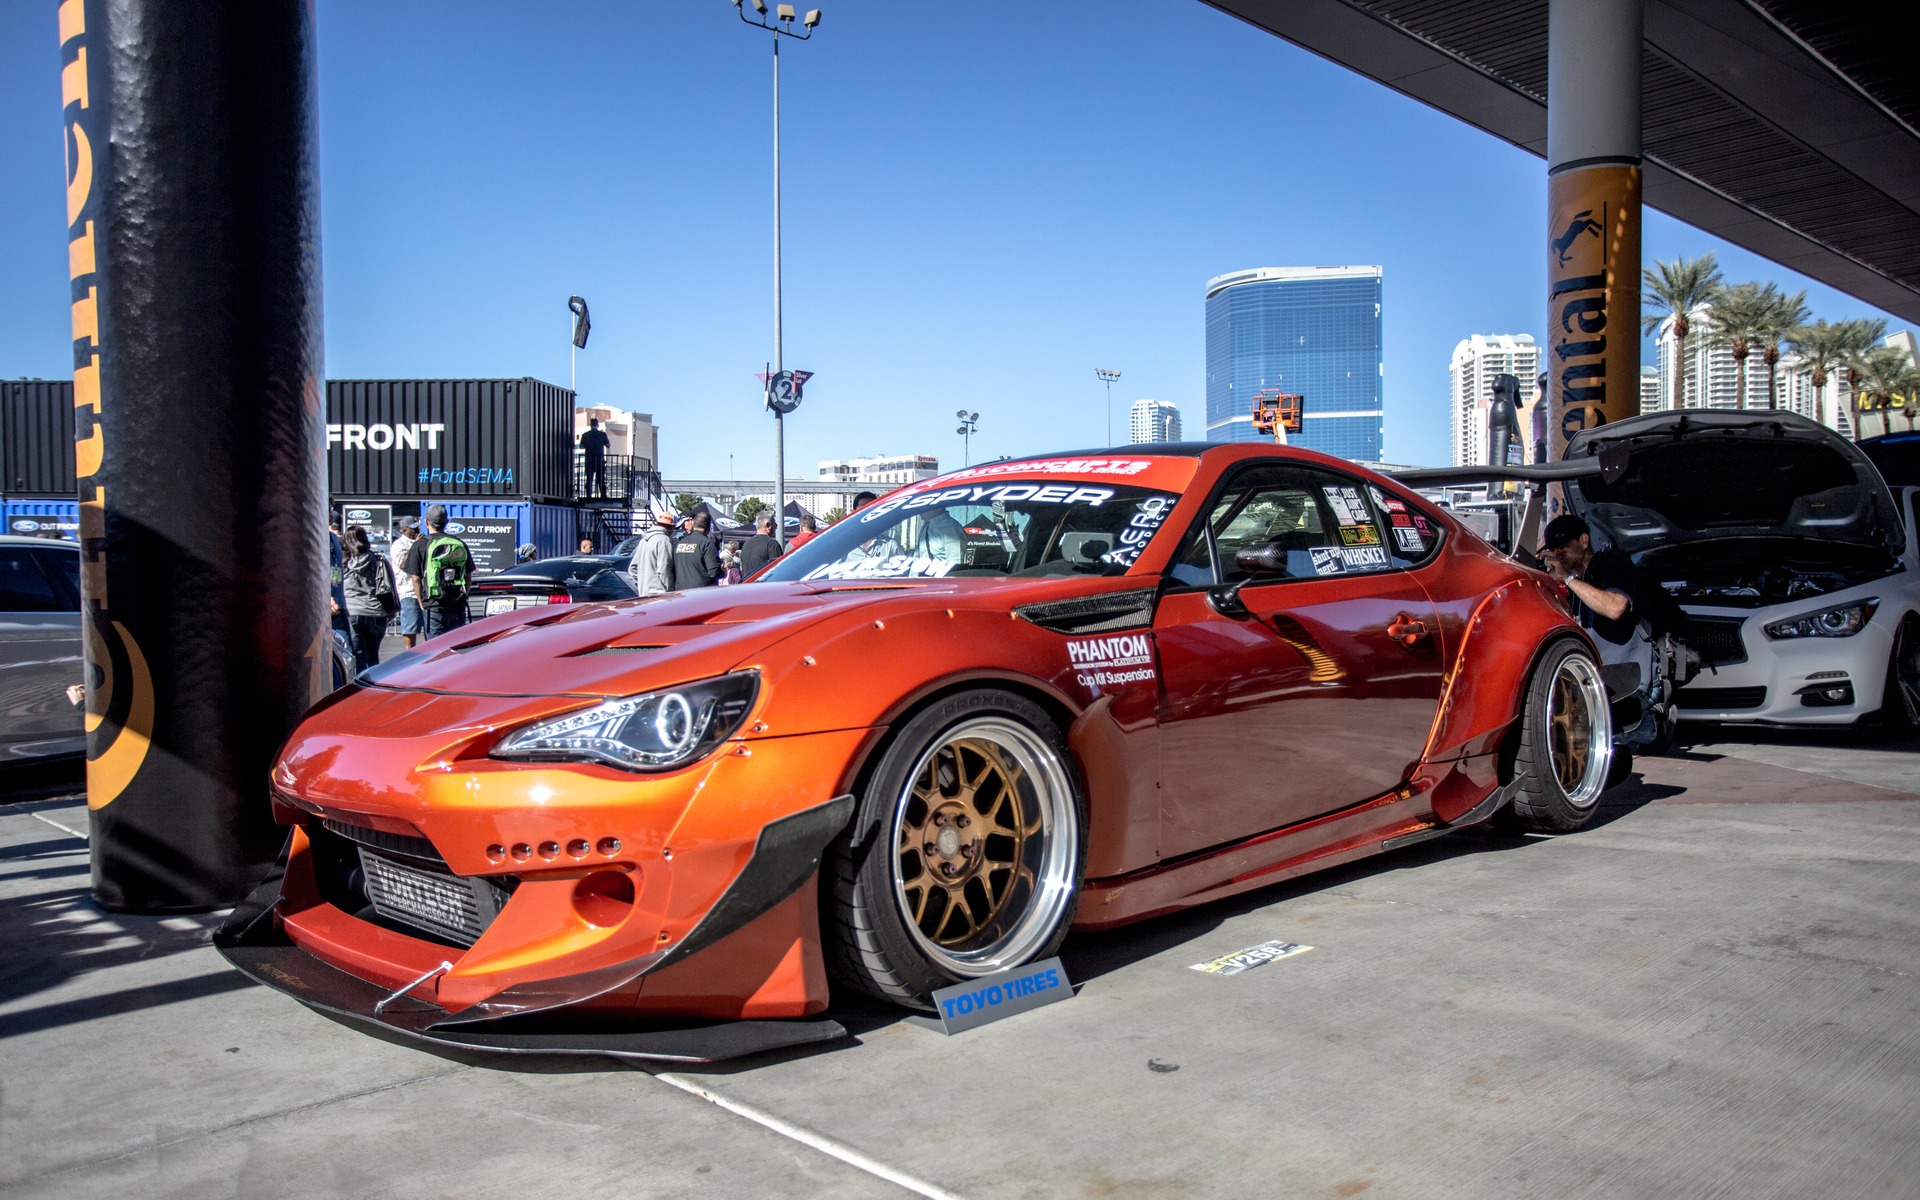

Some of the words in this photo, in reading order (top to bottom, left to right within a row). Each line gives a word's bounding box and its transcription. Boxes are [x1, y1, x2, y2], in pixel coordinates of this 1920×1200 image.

[780, 381, 792, 400] 2
[326, 423, 445, 450] FRONT
[418, 468, 513, 484] #FordSEMA
[901, 485, 1114, 509] SPYDER
[484, 526, 512, 534] FRONT
[1110, 497, 1166, 566] AERO
[1124, 498, 1176, 567] PRODUCTS
[1312, 549, 1330, 564] shut
[1341, 547, 1387, 565] WHISKEY
[1066, 635, 1149, 662] PHANTOM
[1077, 674, 1095, 688] Cup
[1095, 672, 1106, 685] Kit
[1106, 668, 1155, 685] Suspension
[1219, 946, 1286, 968] V258
[942, 985, 1004, 1018] TOYO
[1003, 968, 1060, 1001] TIRES
